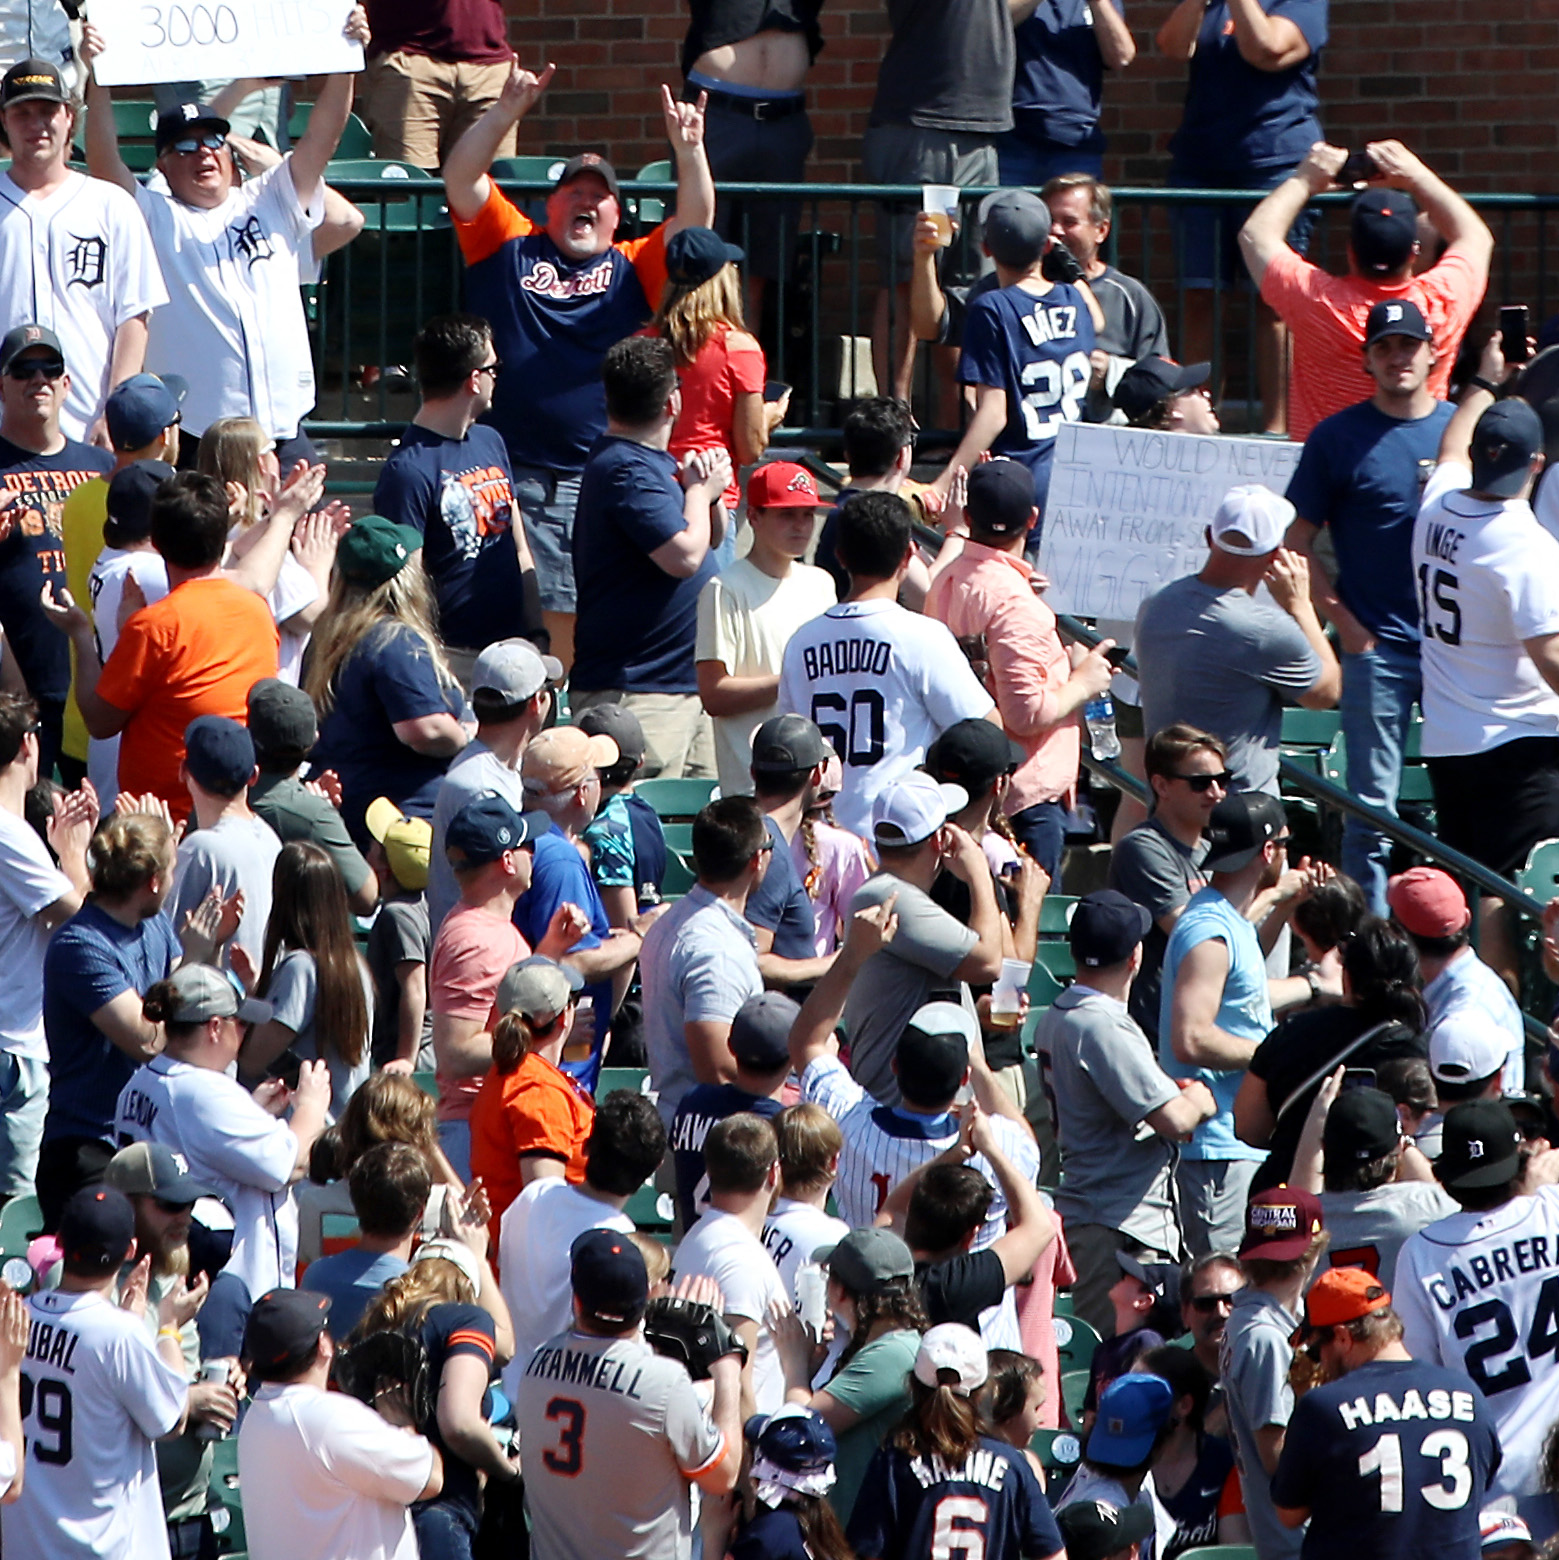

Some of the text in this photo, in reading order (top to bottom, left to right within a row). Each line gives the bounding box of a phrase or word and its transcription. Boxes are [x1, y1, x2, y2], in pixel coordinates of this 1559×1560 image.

[139, 2, 240, 49] 3000
[1113, 432, 1219, 474] WOULD
[1228, 443, 1294, 478] NEVE
[1424, 521, 1465, 566] INGE
[1418, 562, 1462, 648] 15
[803, 639, 892, 681] BADDOO
[811, 688, 885, 768] 60
[24, 1318, 81, 1375] UBAL
[525, 1346, 644, 1401] TRAMMELL
[1338, 1388, 1477, 1430] HAASE
[542, 1395, 588, 1480] 3
[909, 1448, 1010, 1495] KALINE
[1358, 1427, 1474, 1514] 13
[929, 1495, 988, 1560] 6
